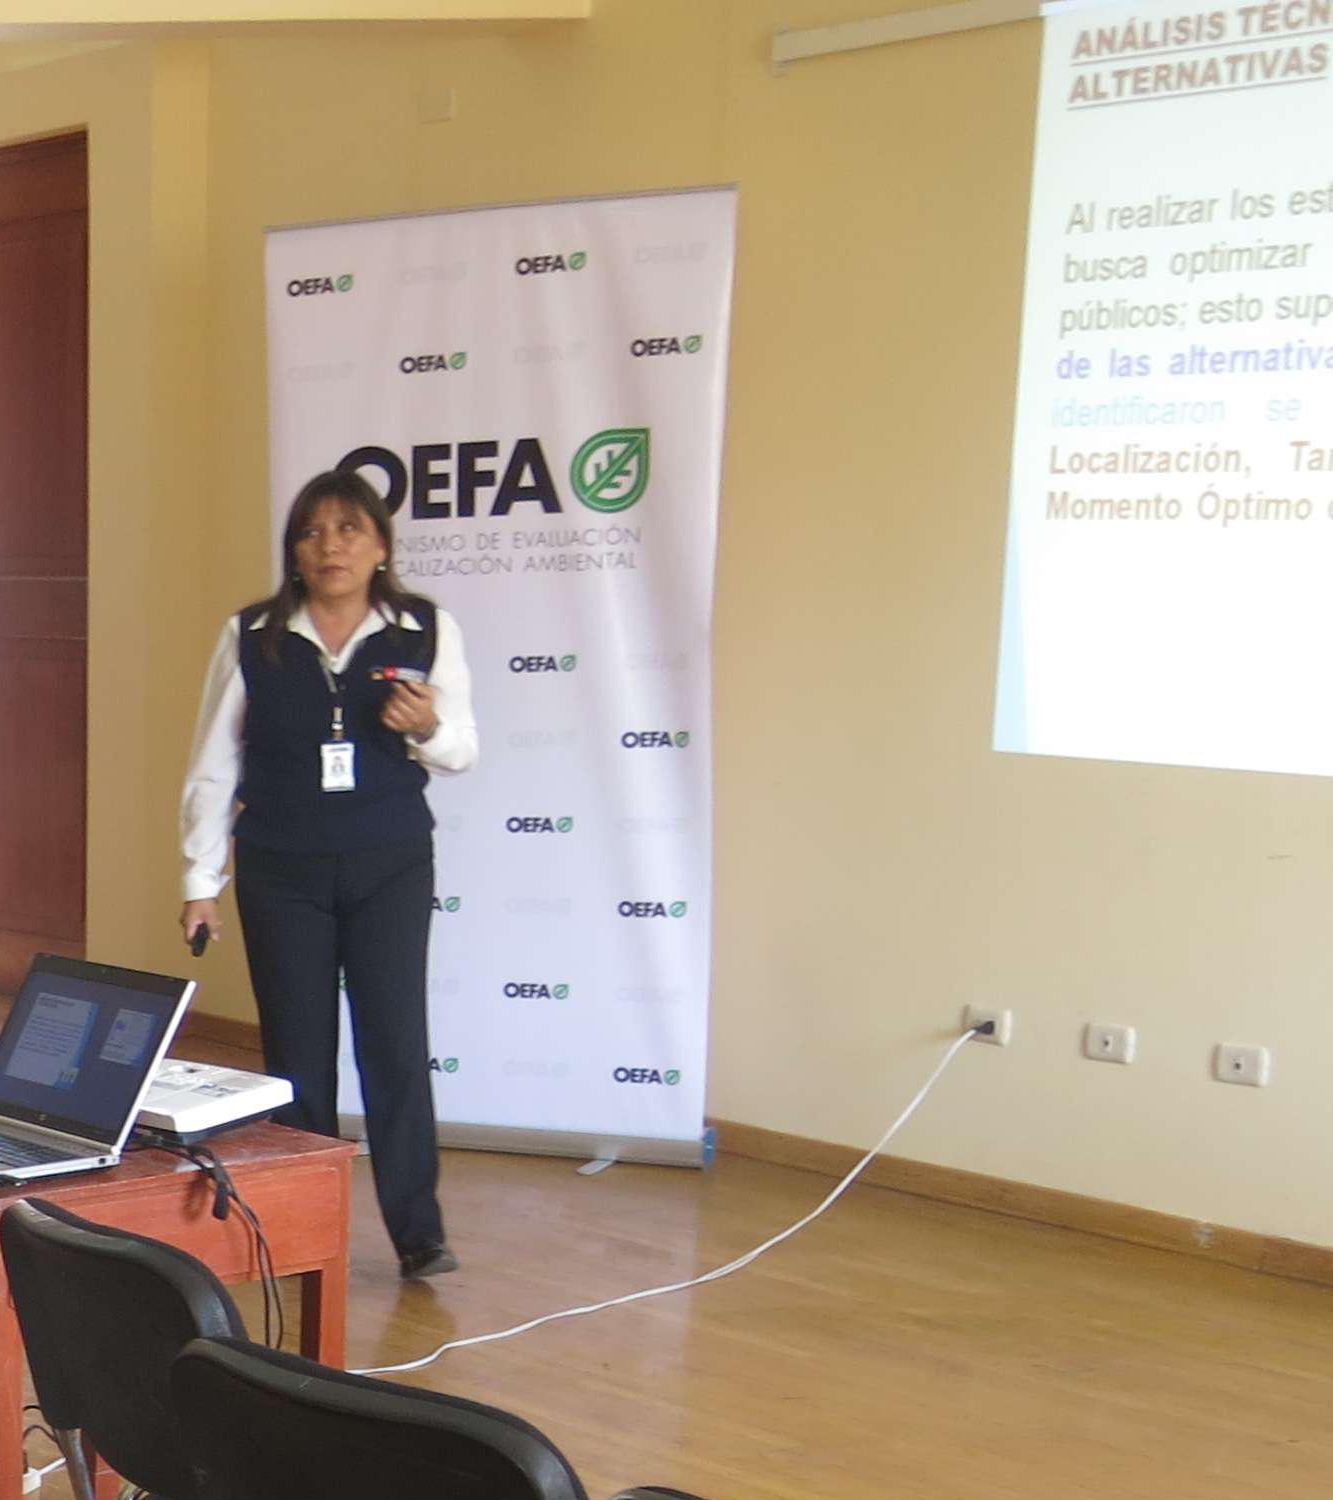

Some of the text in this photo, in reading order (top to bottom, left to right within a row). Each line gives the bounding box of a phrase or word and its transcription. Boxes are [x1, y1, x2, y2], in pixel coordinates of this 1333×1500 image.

[1071, 11, 1227, 59] ANÁLISIS
[1068, 43, 1329, 103] ALTERNATIVAS
[1065, 203, 1096, 235] Al
[1106, 194, 1220, 231] realizar
[1230, 188, 1275, 220] los
[515, 254, 566, 276] OEFA
[1063, 238, 1314, 283] busca optimizar
[287, 277, 335, 298] OEFA
[1059, 299, 1187, 340] públicos;
[1199, 292, 1263, 324] esto
[630, 336, 682, 357] OEFA
[400, 354, 447, 374] OEFA
[1056, 349, 1091, 380] de
[1109, 347, 1151, 378] las
[1267, 398, 1301, 421] se
[1049, 443, 1251, 478] Localización,
[335, 438, 564, 520] OEFA
[1045, 490, 1182, 520] Momento
[1197, 483, 1312, 527] Óptimo
[396, 523, 642, 553] NISMO DE EVALUACIÓN
[395, 551, 638, 577] CALIZACIÓN AMBIENTAL
[509, 655, 558, 674] OEFA
[621, 730, 673, 749] OEFA
[506, 816, 554, 834] OEFA
[617, 900, 667, 918] OEFA
[503, 982, 551, 1000] OEFA
[613, 1066, 663, 1085] OEFA
